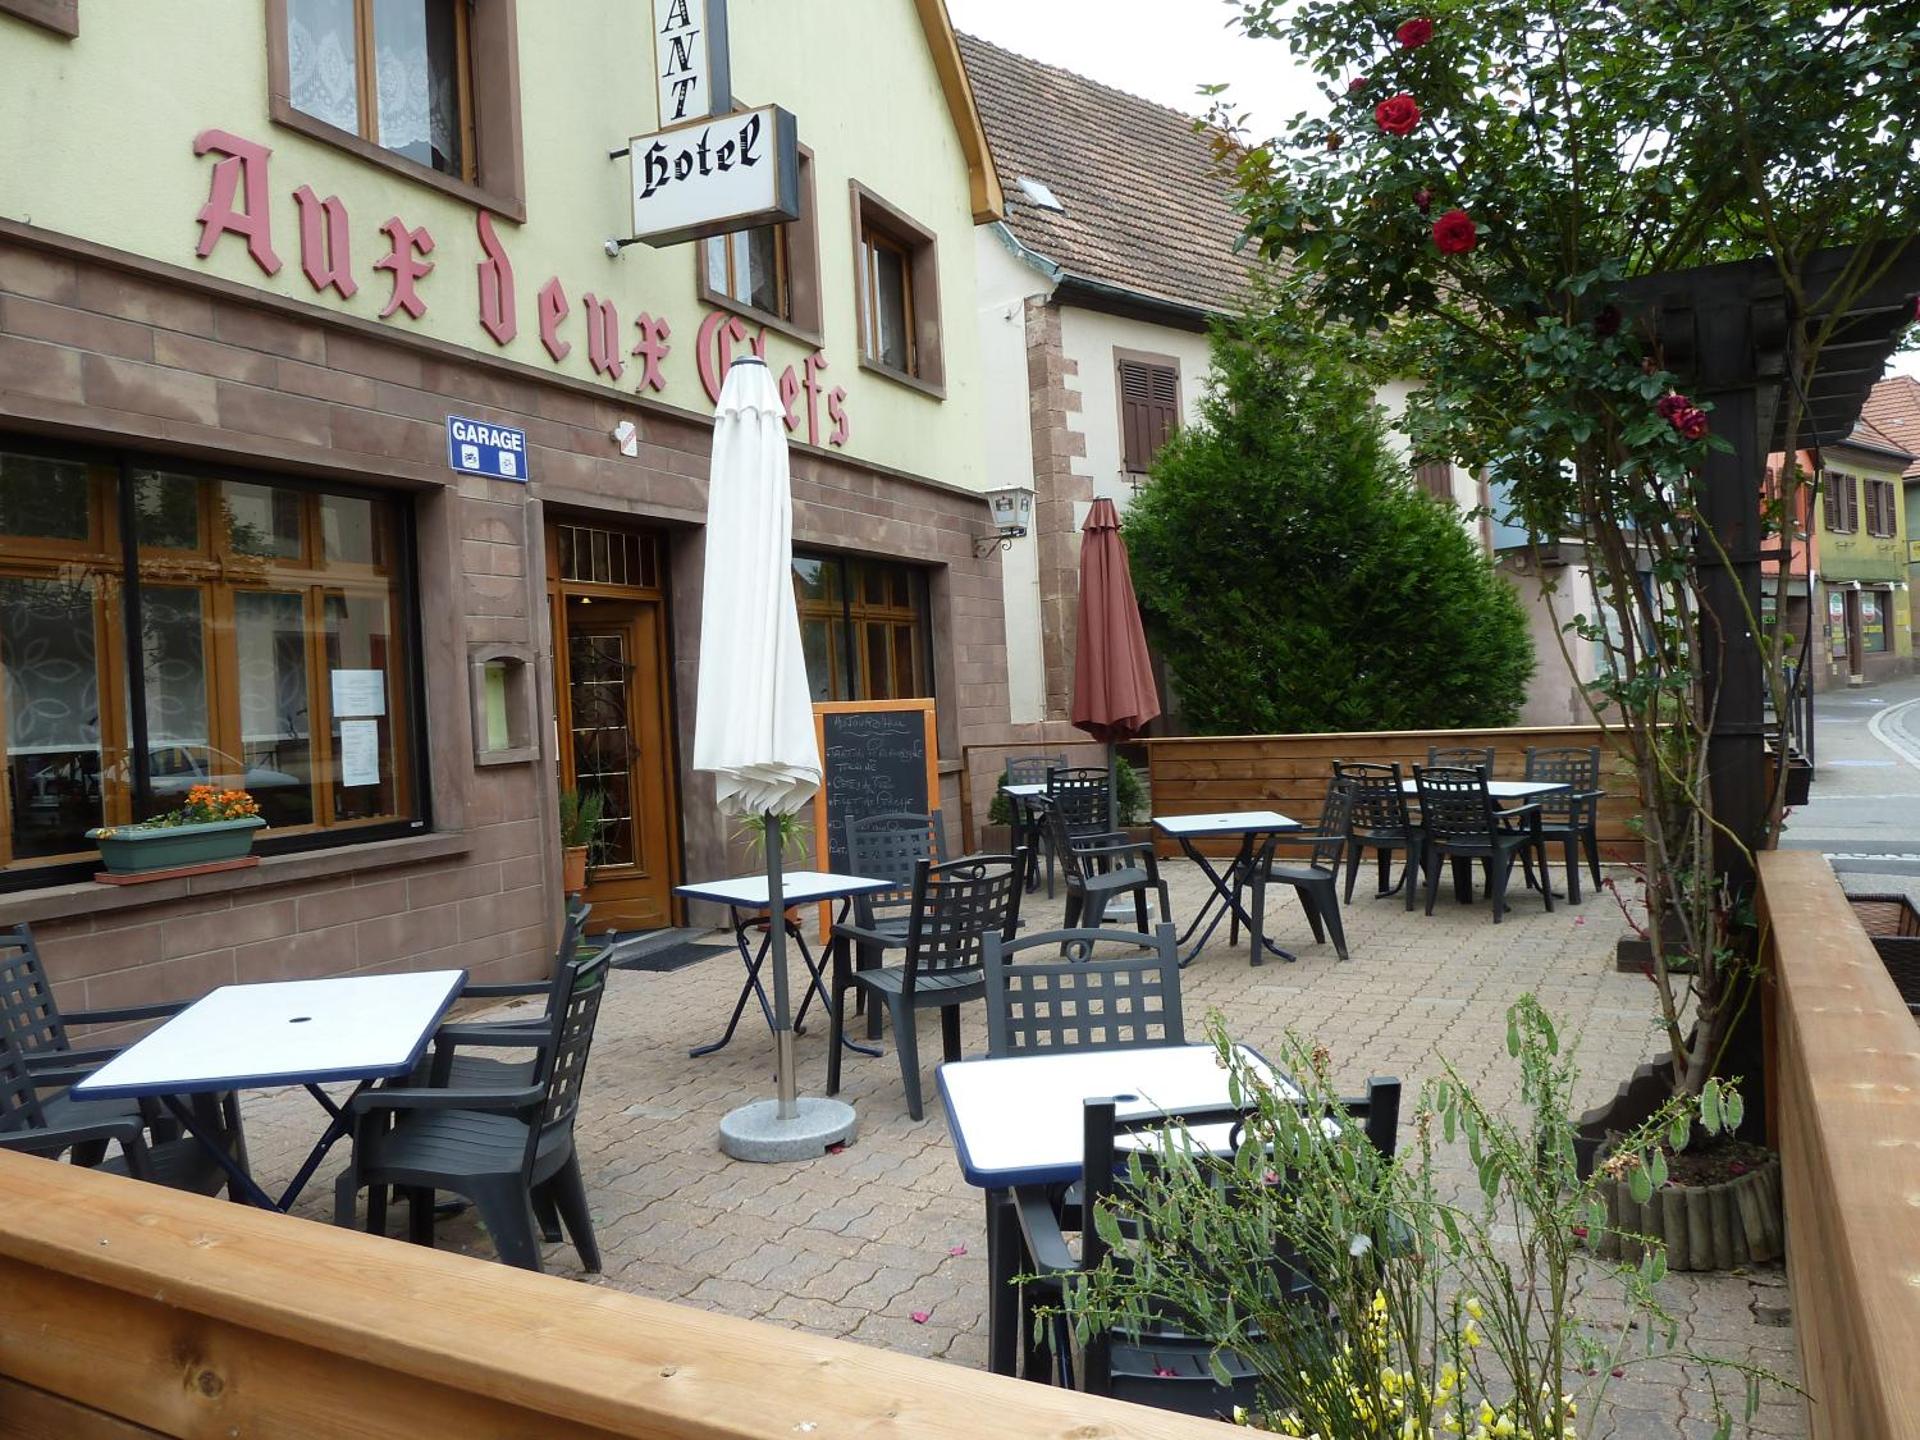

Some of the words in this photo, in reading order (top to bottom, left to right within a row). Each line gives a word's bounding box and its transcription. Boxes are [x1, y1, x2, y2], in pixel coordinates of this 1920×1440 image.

[193, 128, 435, 320] Aux
[476, 209, 671, 393] deux
[696, 310, 850, 448] Cefs
[452, 421, 523, 452] GARAGE
